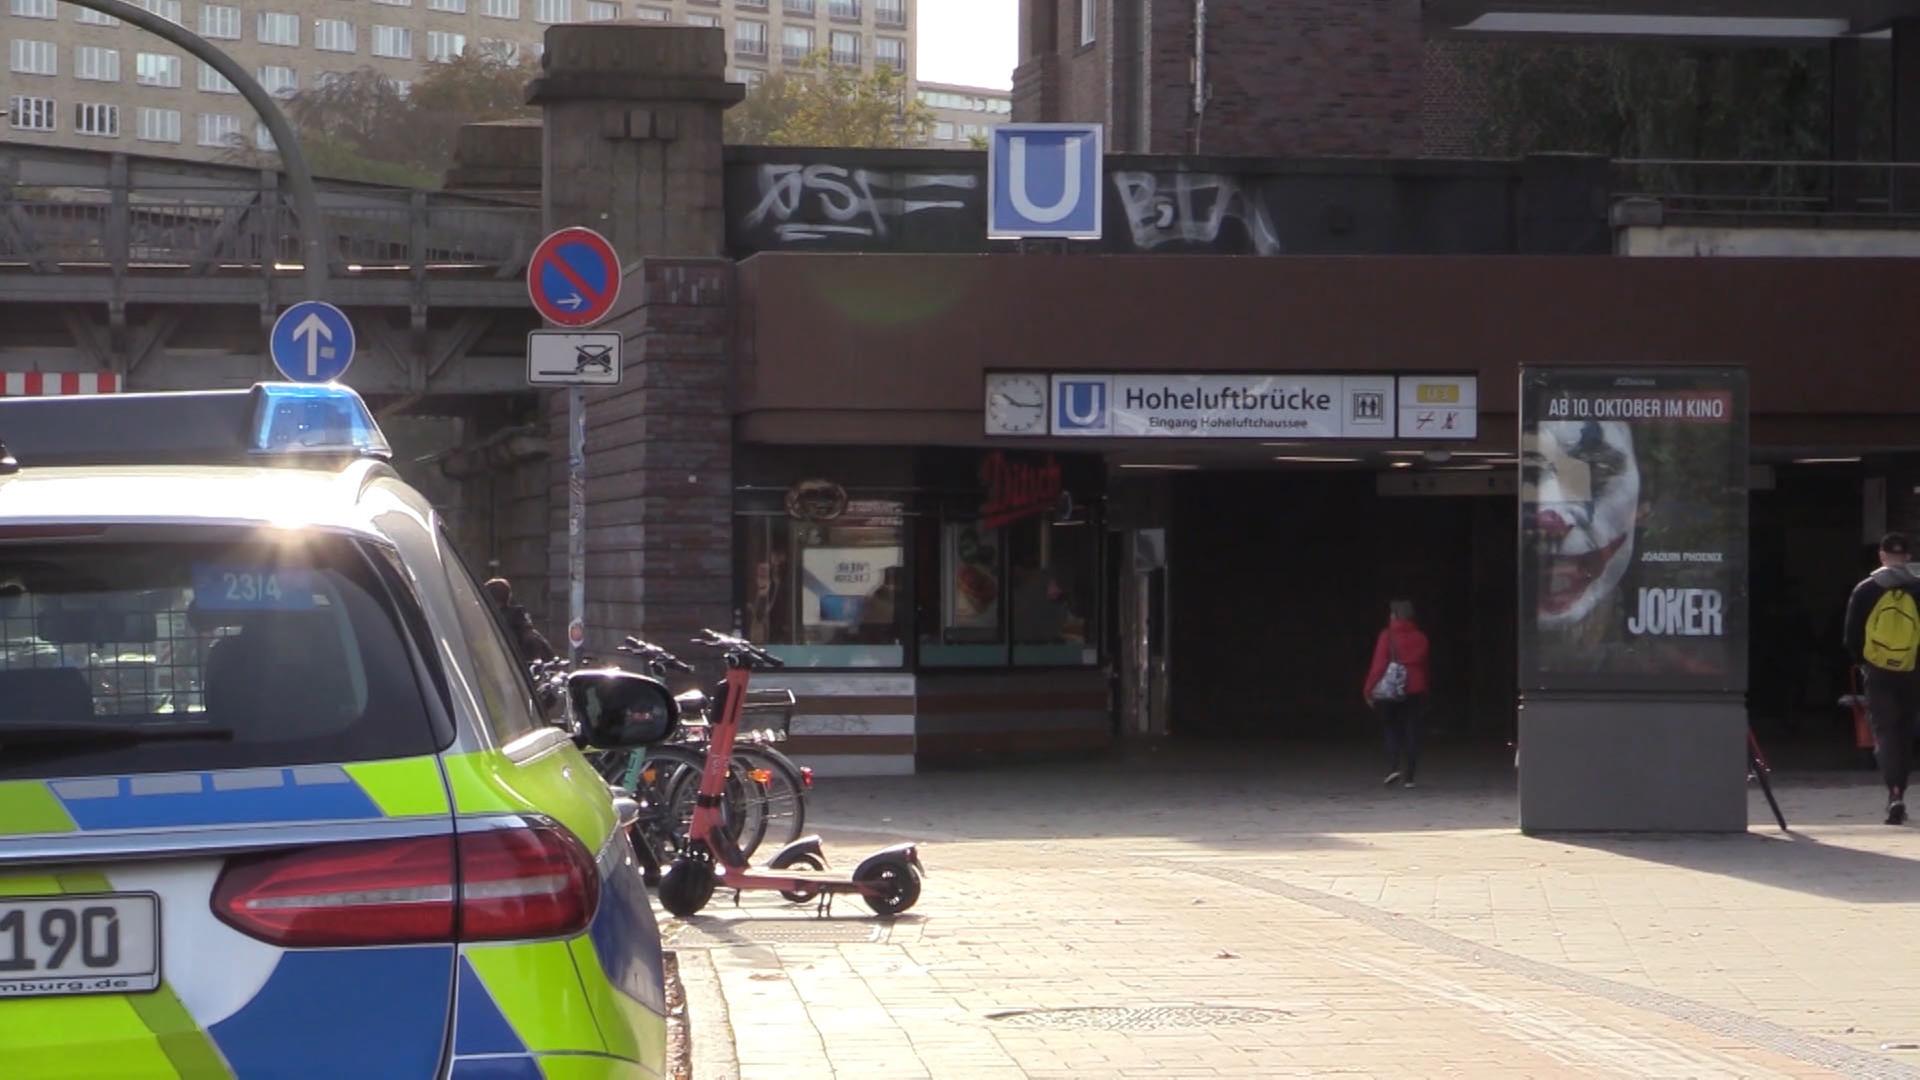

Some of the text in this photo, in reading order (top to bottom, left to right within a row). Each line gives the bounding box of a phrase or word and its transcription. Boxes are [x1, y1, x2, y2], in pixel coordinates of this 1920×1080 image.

[1009, 136, 1080, 223] U
[1065, 384, 1098, 425] U
[1126, 387, 1331, 410] Hoheluftbrücke
[1548, 398, 1724, 417] AB 10. OKTOBER IM KINO
[1149, 416, 1308, 429] Eingang Hoheluftchaussee
[1641, 552, 1723, 562] JOAQUIN PHOENIX
[1627, 587, 1723, 635] JOKER
[0, 906, 120, 971] 190
